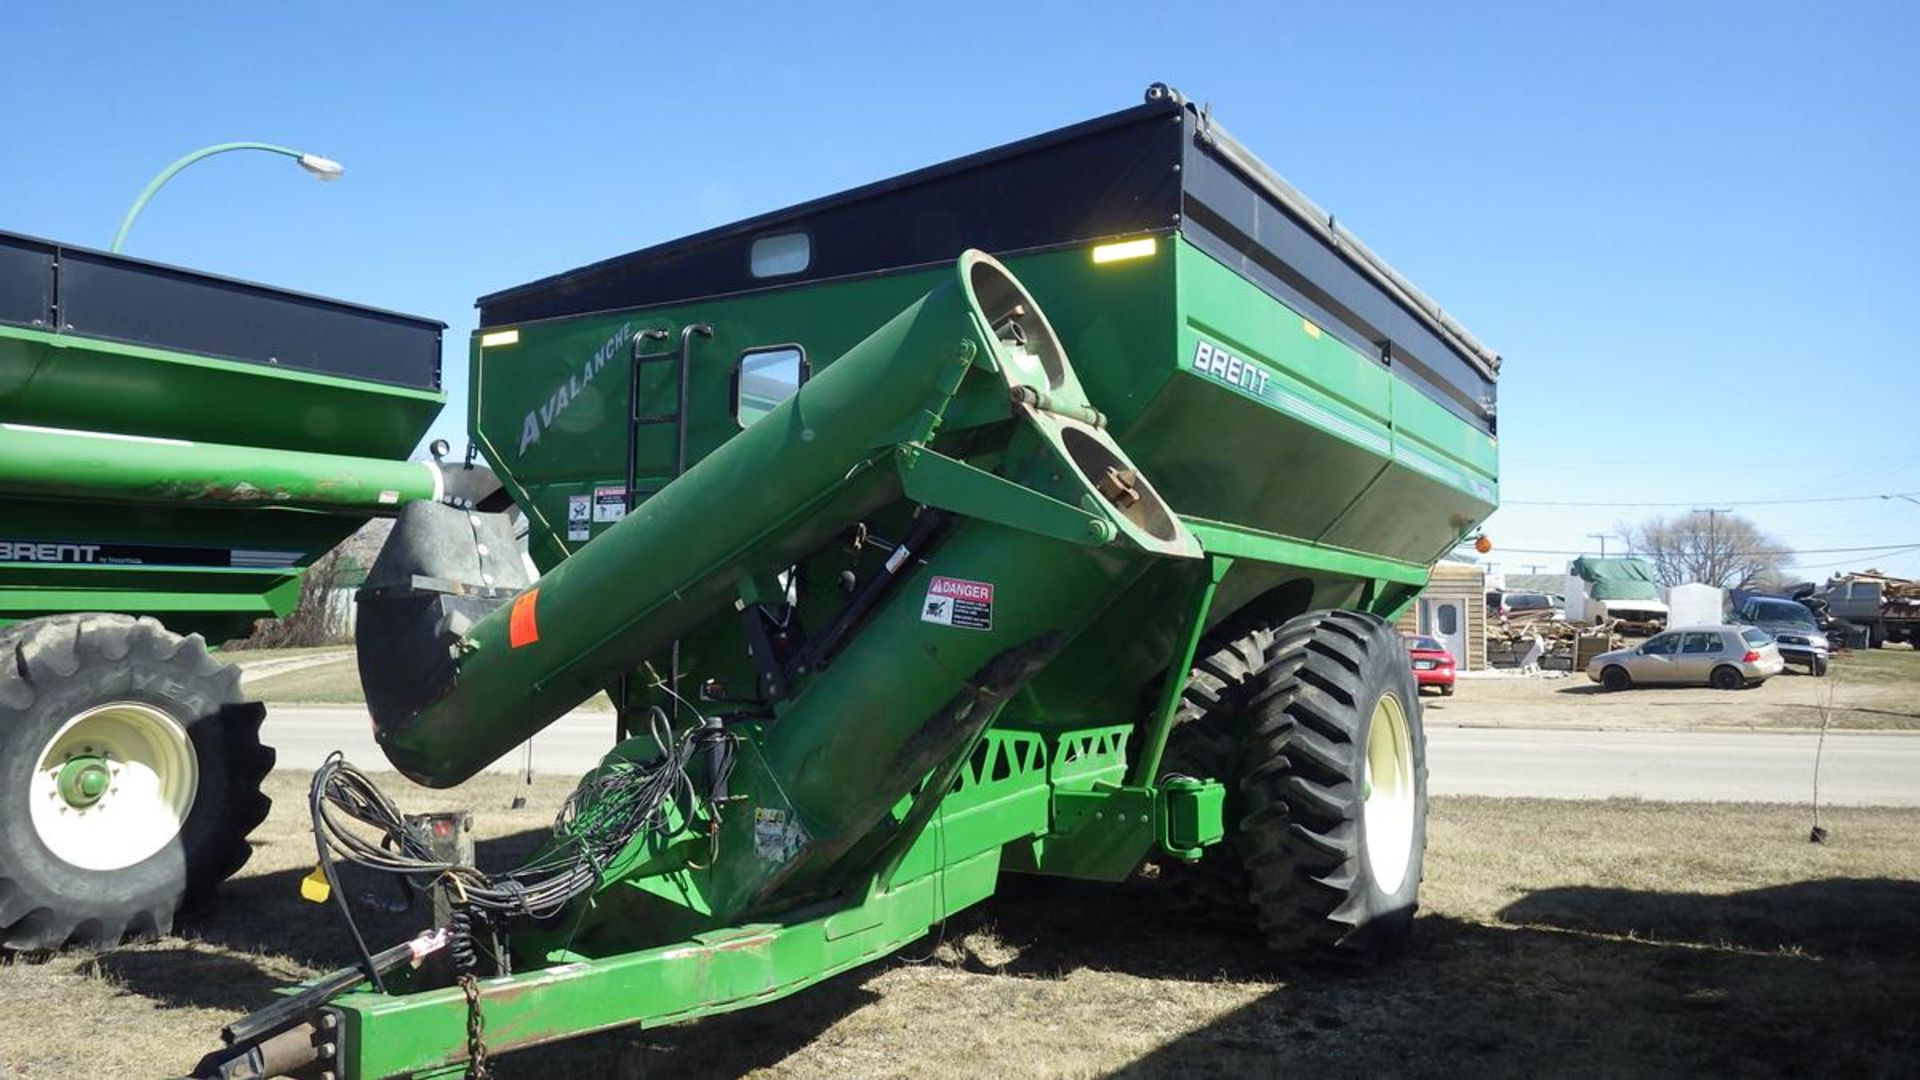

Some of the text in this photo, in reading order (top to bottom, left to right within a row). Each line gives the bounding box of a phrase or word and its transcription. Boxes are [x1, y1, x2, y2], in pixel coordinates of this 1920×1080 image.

[1194, 340, 1270, 394] BRENT
[518, 321, 633, 458] AVALANCHE
[0, 542, 101, 562] BRENT
[943, 582, 989, 599] DANGER
